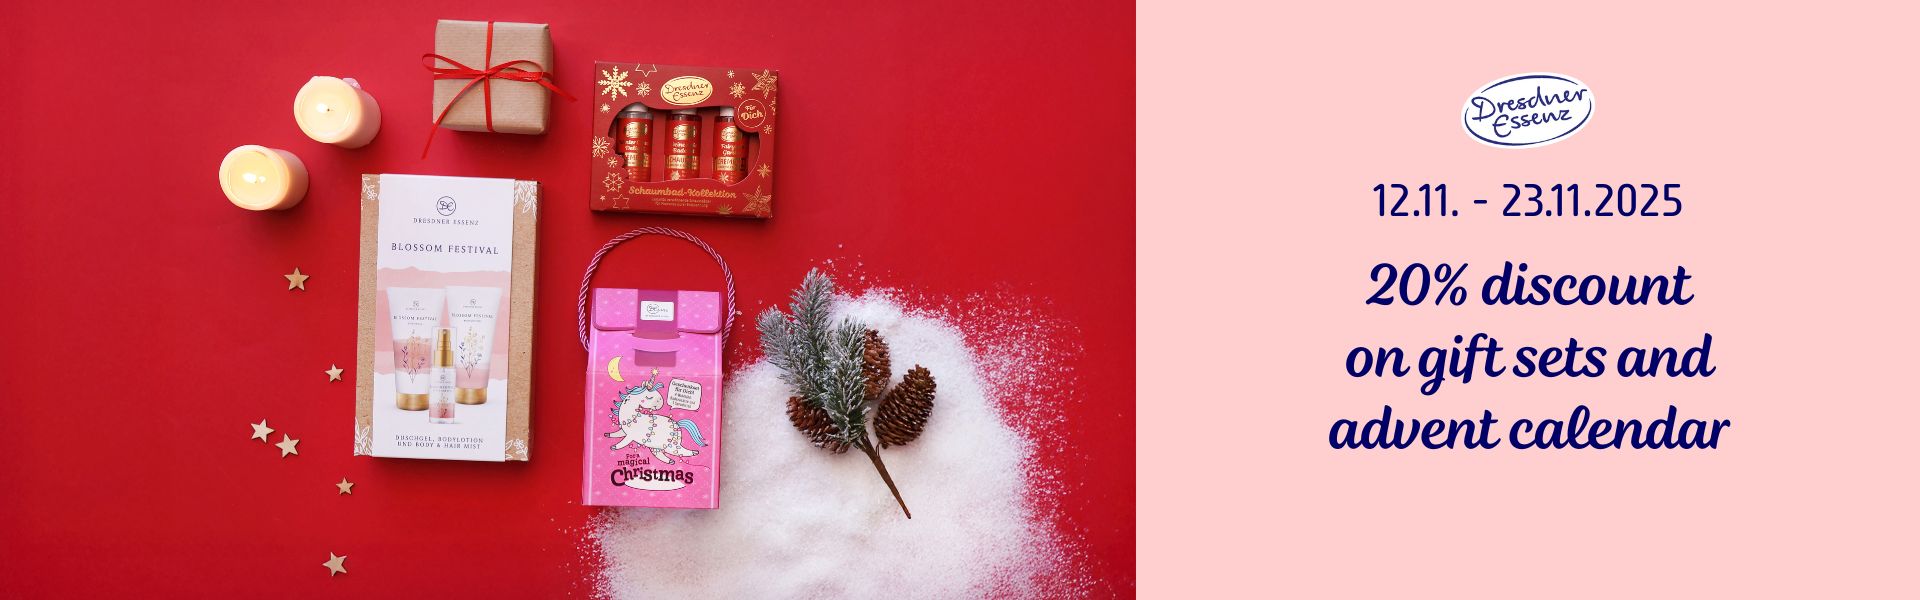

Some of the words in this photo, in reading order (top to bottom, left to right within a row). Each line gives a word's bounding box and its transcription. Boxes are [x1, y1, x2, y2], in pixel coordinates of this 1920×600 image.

[664, 81, 709, 94] Dresdner
[673, 90, 705, 101] Essenz
[740, 110, 763, 120] Dich
[628, 186, 737, 199] Schaumbad-Kollektion
[413, 217, 450, 225] DRESDNER
[391, 243, 443, 253] BLOSSOM
[448, 245, 499, 255] FESTIVAL
[438, 436, 484, 444] BODYLOTION
[617, 457, 651, 467] magical
[610, 467, 694, 487] Christmas
